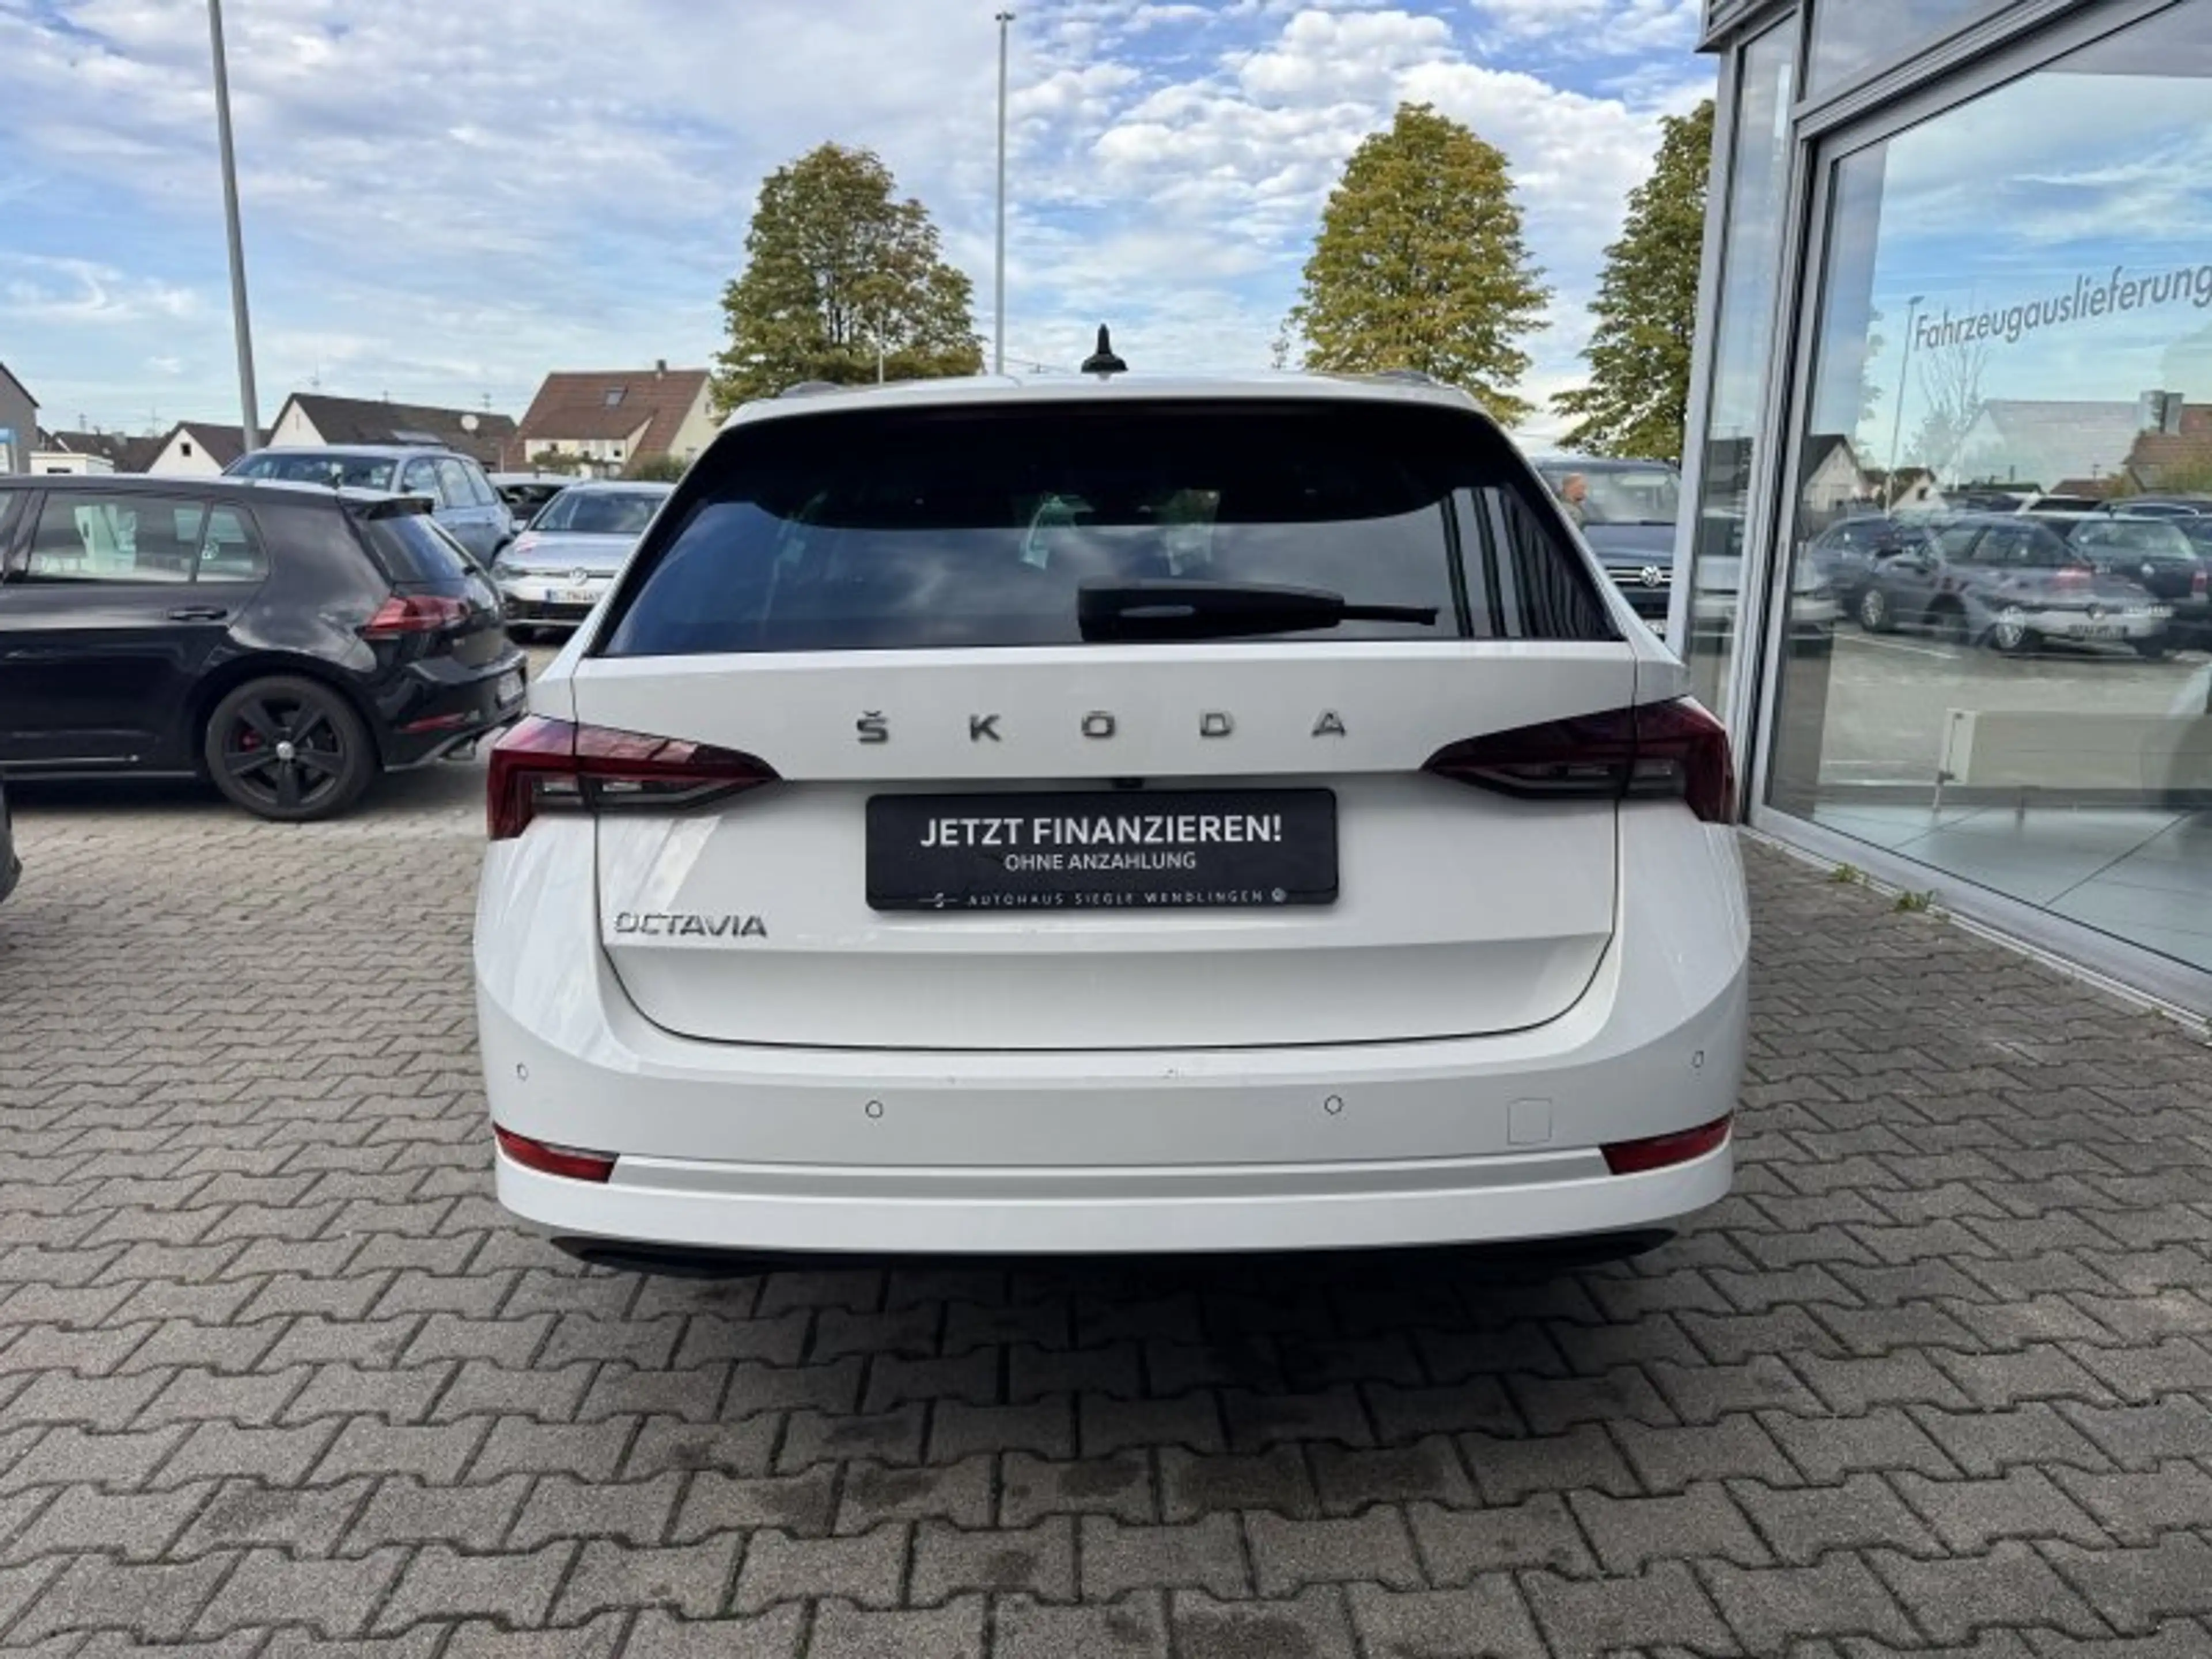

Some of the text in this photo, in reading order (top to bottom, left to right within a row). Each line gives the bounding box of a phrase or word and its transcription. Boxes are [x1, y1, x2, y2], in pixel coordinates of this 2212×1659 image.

[1913, 265, 2212, 351] Fahrzeugauslieferung
[921, 815, 1282, 847] JETZT FINANZIEREN!
[1004, 851, 1196, 871] OHNE ANZAHLUNG
[968, 892, 1064, 906] AUTOHAUS
[614, 911, 768, 938] OCTAVIA
